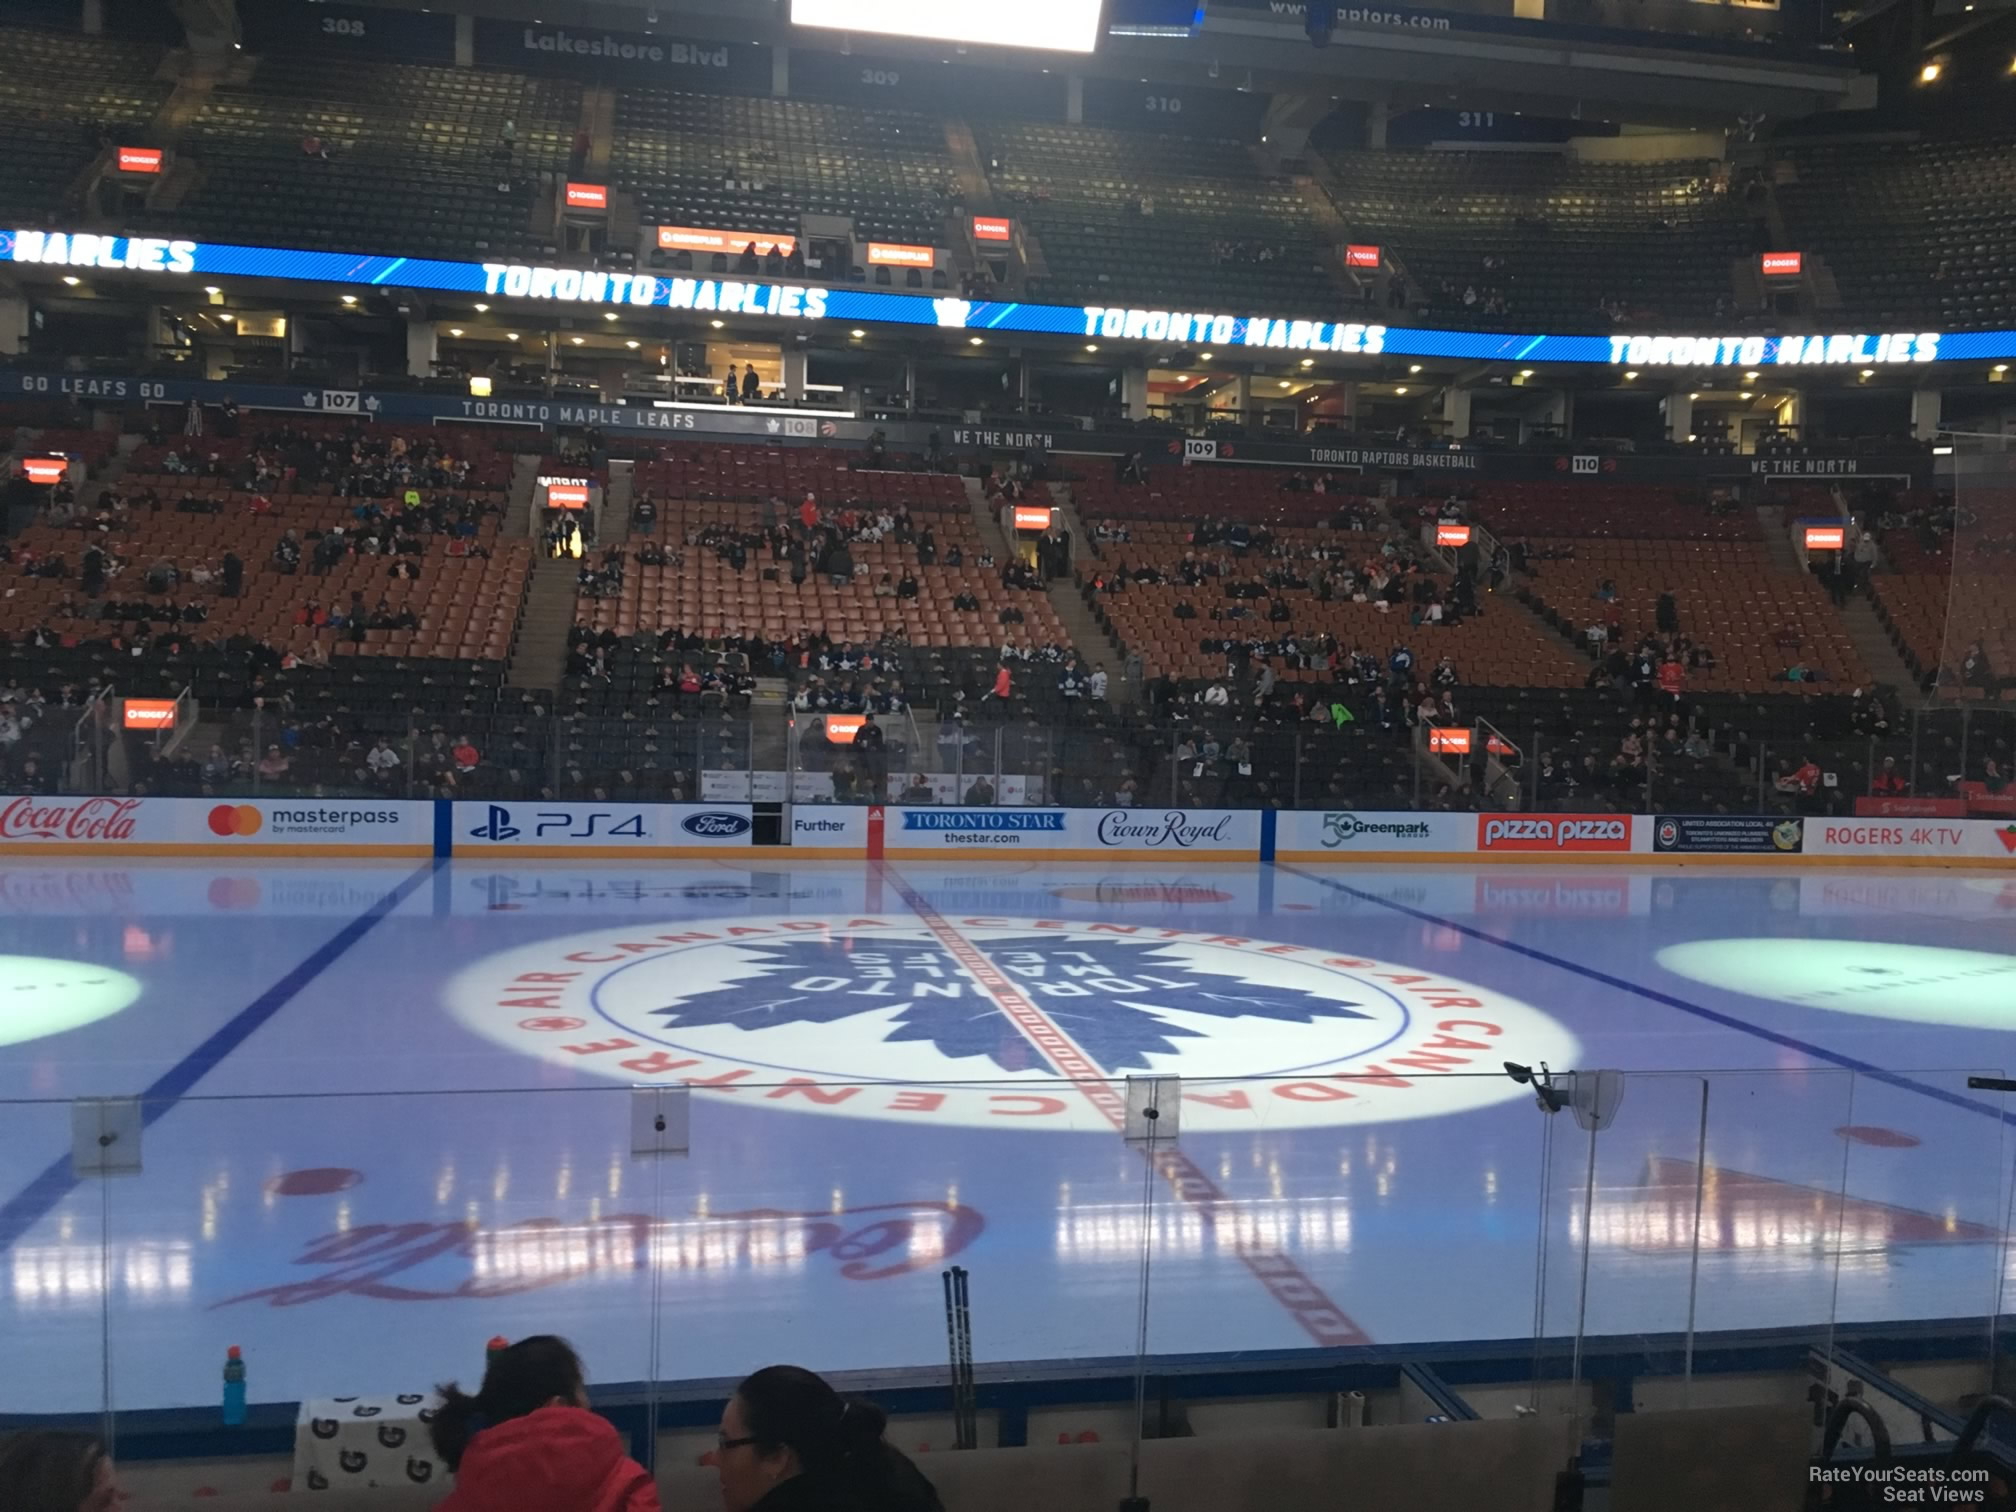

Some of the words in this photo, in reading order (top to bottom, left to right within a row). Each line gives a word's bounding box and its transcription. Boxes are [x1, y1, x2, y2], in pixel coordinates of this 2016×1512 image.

[321, 17, 366, 38] 308
[523, 28, 664, 62] Lakeshore
[671, 44, 729, 68] Blvd
[861, 69, 899, 86] 309
[1145, 96, 1182, 113] 310
[1458, 111, 1494, 128] 311
[13, 230, 197, 273] MARLIES
[482, 263, 657, 306] TORONTO
[668, 278, 829, 319] MARLIES
[1083, 306, 1233, 345] TORONTO
[1244, 317, 1386, 354] MARLIES
[1609, 335, 1769, 365] TORONTO
[1777, 333, 1940, 364] MARLIES
[22, 375, 49, 392] GO
[61, 378, 127, 396] LEAFS
[139, 383, 165, 398] GO
[325, 393, 357, 410] 107
[462, 401, 550, 421] TORONTO
[560, 407, 622, 425] MAPLE
[636, 412, 696, 429] LEAFS
[786, 419, 816, 436] 108
[953, 430, 971, 445] WE
[974, 431, 1001, 446] THE
[1187, 442, 1214, 456] 109
[1310, 448, 1359, 464] TORONTO
[1361, 450, 1410, 466] RAPTORS
[1412, 454, 1477, 468] BASKETBALL
[1575, 457, 1599, 472] 110
[1751, 460, 1768, 473] WE
[1773, 460, 1800, 473] THE
[1806, 459, 1857, 473] NORTH
[0, 796, 144, 840] Coca-Cola
[272, 808, 399, 828] masterpass
[536, 813, 648, 838] PS4
[695, 815, 739, 834] Ford
[794, 819, 846, 833] Further
[913, 813, 1004, 829] TORONTO
[1007, 813, 1056, 829] STAR
[272, 825, 284, 834] by
[287, 824, 346, 834] mastercard
[944, 832, 1021, 843] thestar.com
[1097, 810, 1160, 846] Crown
[1144, 810, 1232, 847] Royal
[1352, 820, 1430, 838] Greenpark
[1485, 820, 1554, 846] pizza
[1557, 820, 1626, 846] pizza
[1825, 827, 1903, 845] ROGERS
[1910, 828, 1933, 845] 4K
[1937, 828, 1963, 845] TV
[498, 971, 584, 1009] AIR
[565, 917, 894, 963] CANADA
[962, 917, 1308, 955] CENTRE
[1374, 972, 1489, 1010] AIR
[1184, 1018, 1505, 1111] CANADA
[560, 1037, 1068, 1116] CENTRE
